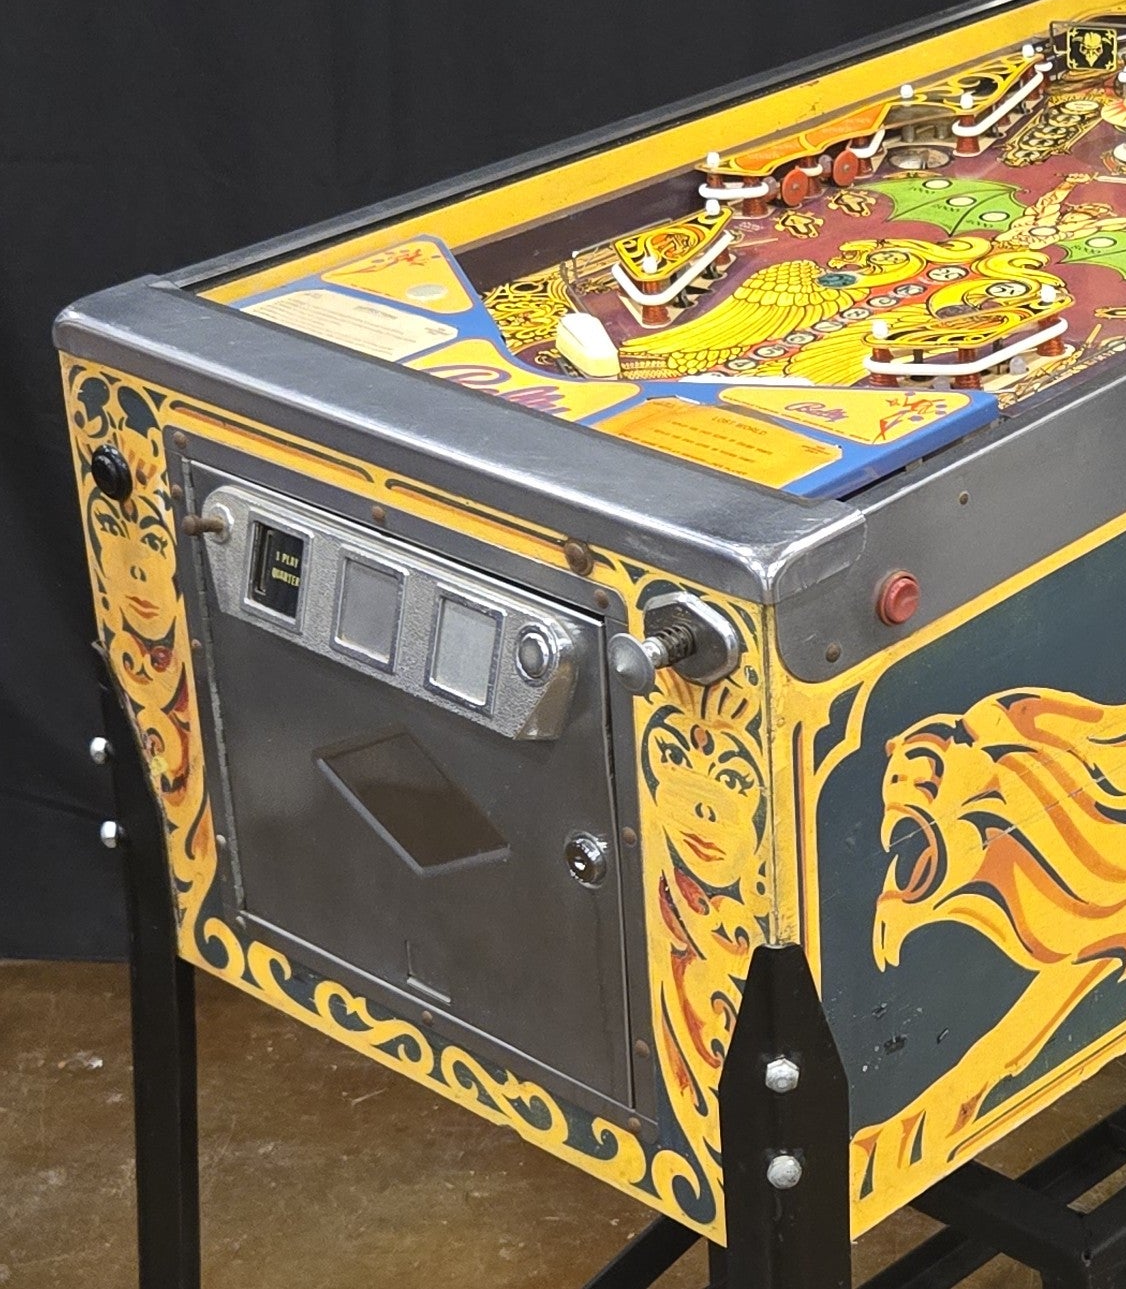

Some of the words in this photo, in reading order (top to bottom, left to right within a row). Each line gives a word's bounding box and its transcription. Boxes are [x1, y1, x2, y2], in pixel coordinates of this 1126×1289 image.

[785, 401, 850, 423] Bally
[275, 550, 280, 561] 1
[281, 553, 299, 568] PLAY
